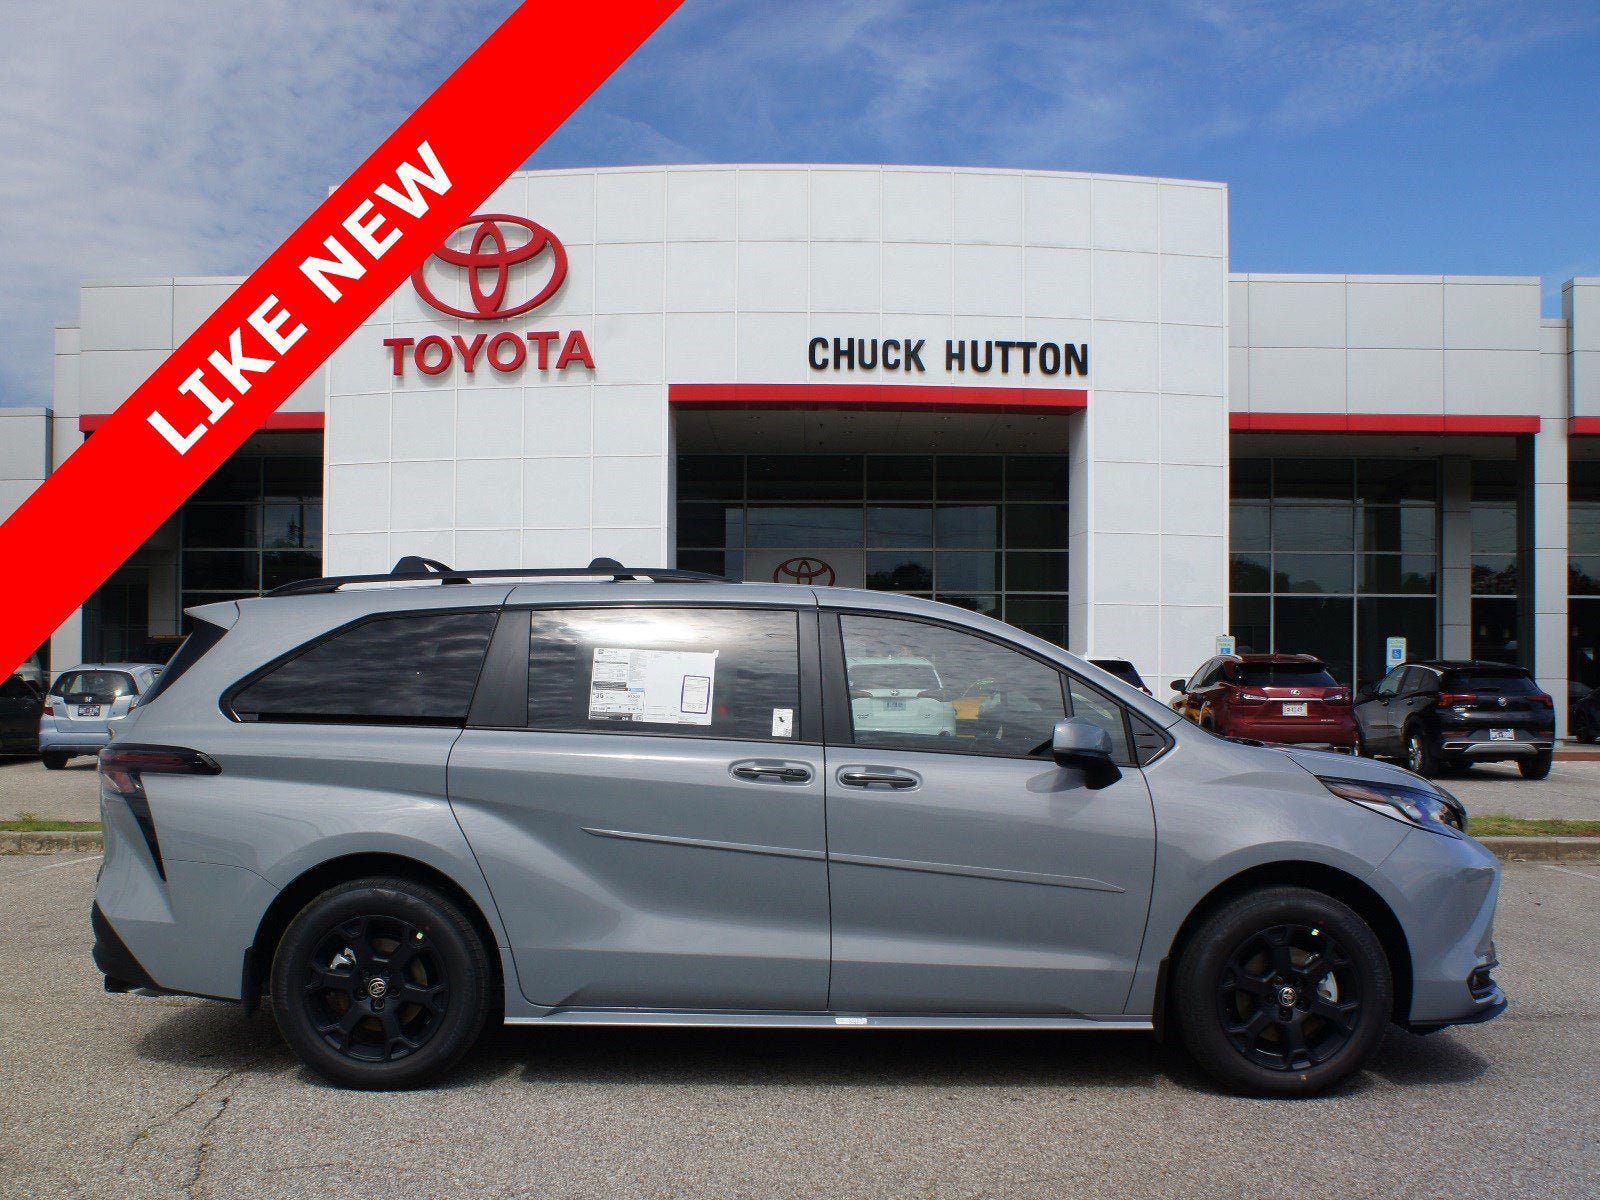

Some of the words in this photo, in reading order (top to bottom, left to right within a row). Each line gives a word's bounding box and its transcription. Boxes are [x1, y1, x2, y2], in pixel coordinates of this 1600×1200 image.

[384, 330, 595, 375] TOYOTA
[808, 336, 926, 373] CHUCK
[945, 339, 1089, 377] HUTTON
